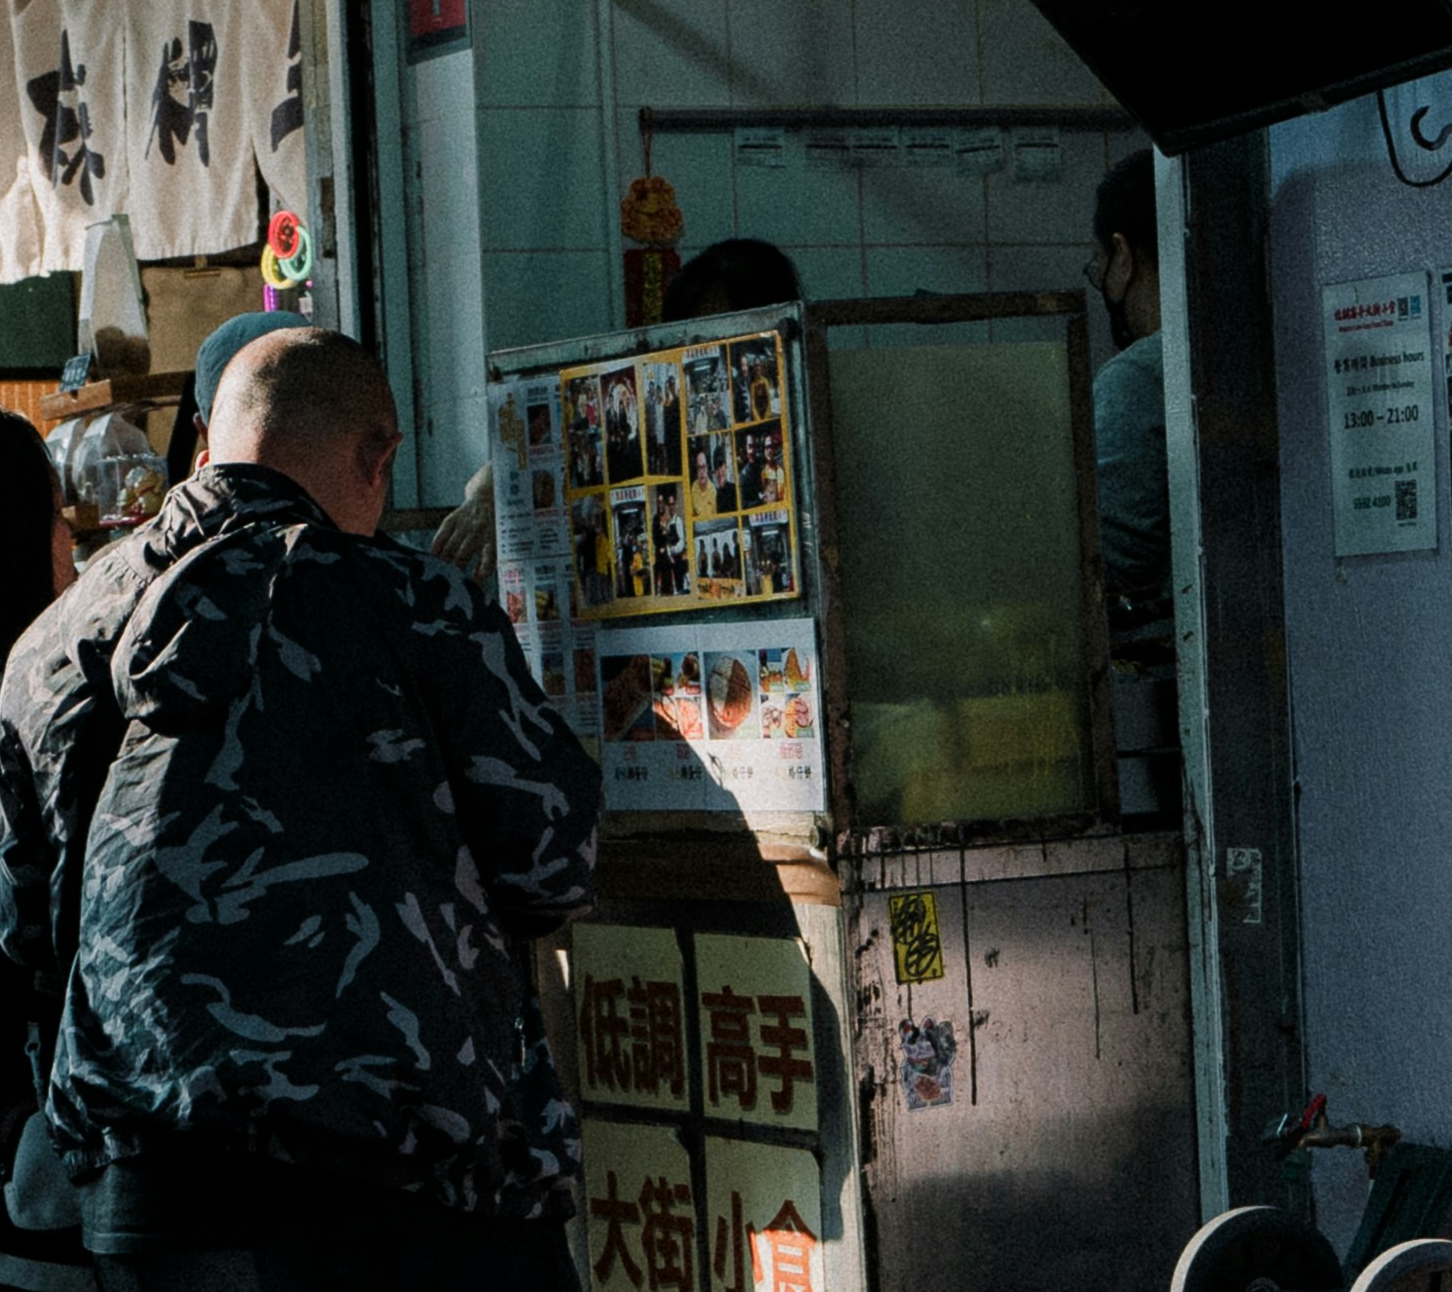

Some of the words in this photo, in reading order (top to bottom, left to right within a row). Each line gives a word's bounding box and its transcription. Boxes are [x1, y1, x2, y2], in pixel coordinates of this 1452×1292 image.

[1344, 408, 1375, 430] 13:00
[1386, 404, 1419, 424] 21:00
[579, 974, 685, 1099] 低調
[701, 984, 815, 1115] 高手
